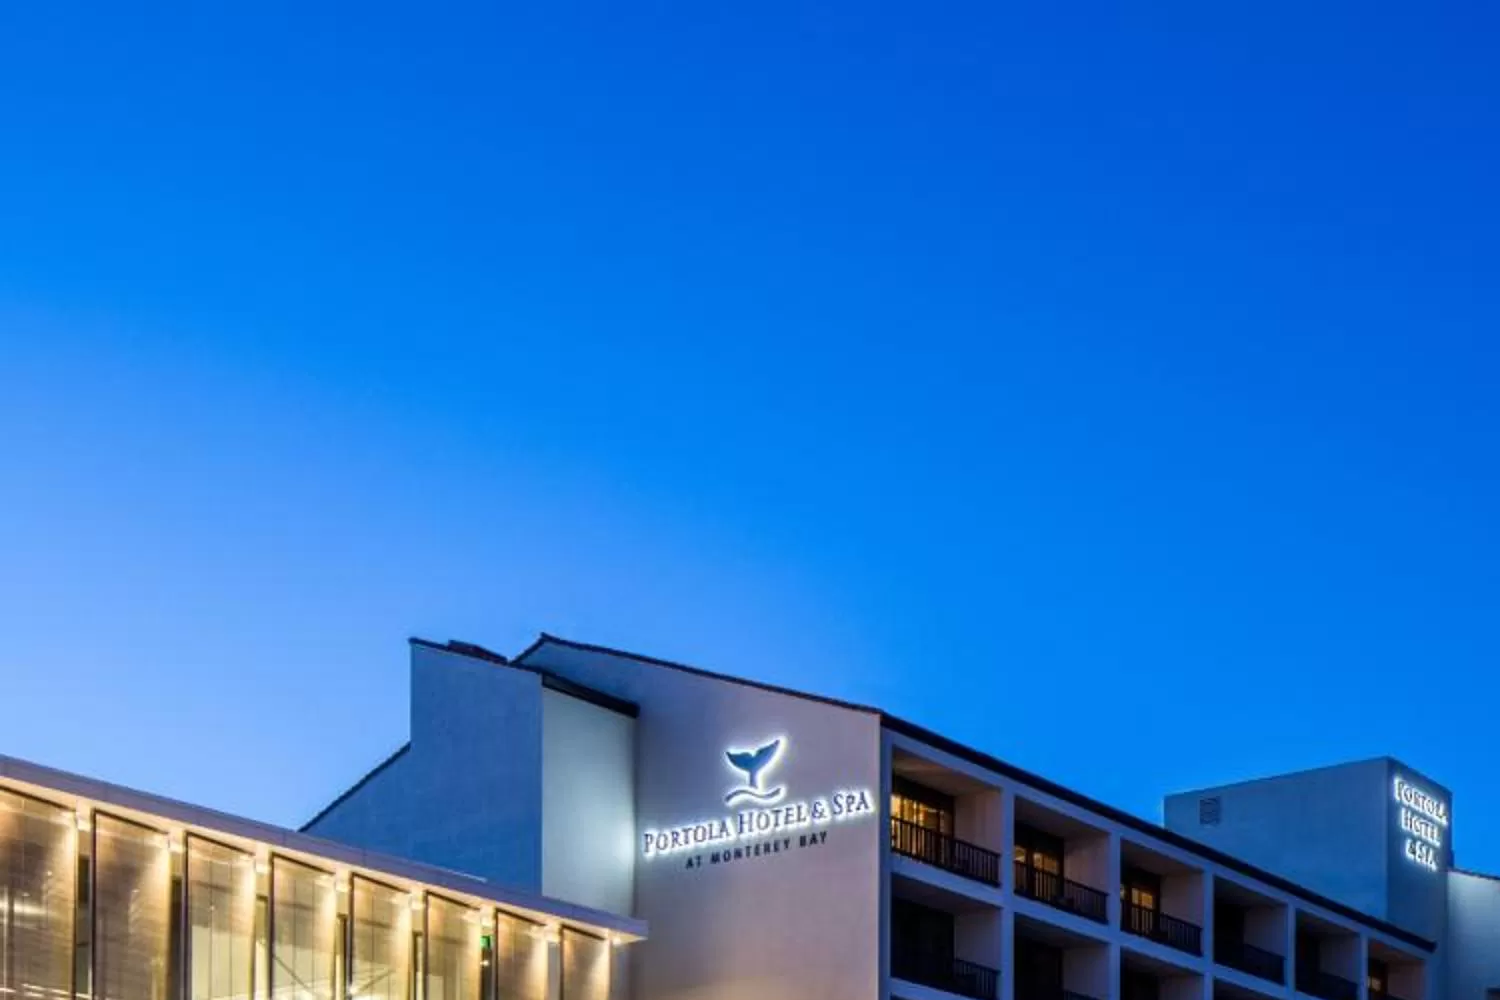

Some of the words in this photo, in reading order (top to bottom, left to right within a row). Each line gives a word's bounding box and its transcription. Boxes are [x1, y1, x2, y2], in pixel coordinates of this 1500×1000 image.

[644, 820, 731, 853] PORTOLA
[738, 803, 807, 835] HOTEL
[811, 801, 828, 820] &
[833, 790, 872, 817] SPA
[684, 851, 703, 870] AT
[710, 838, 790, 865] MONTEREY
[800, 831, 828, 847] BAY
